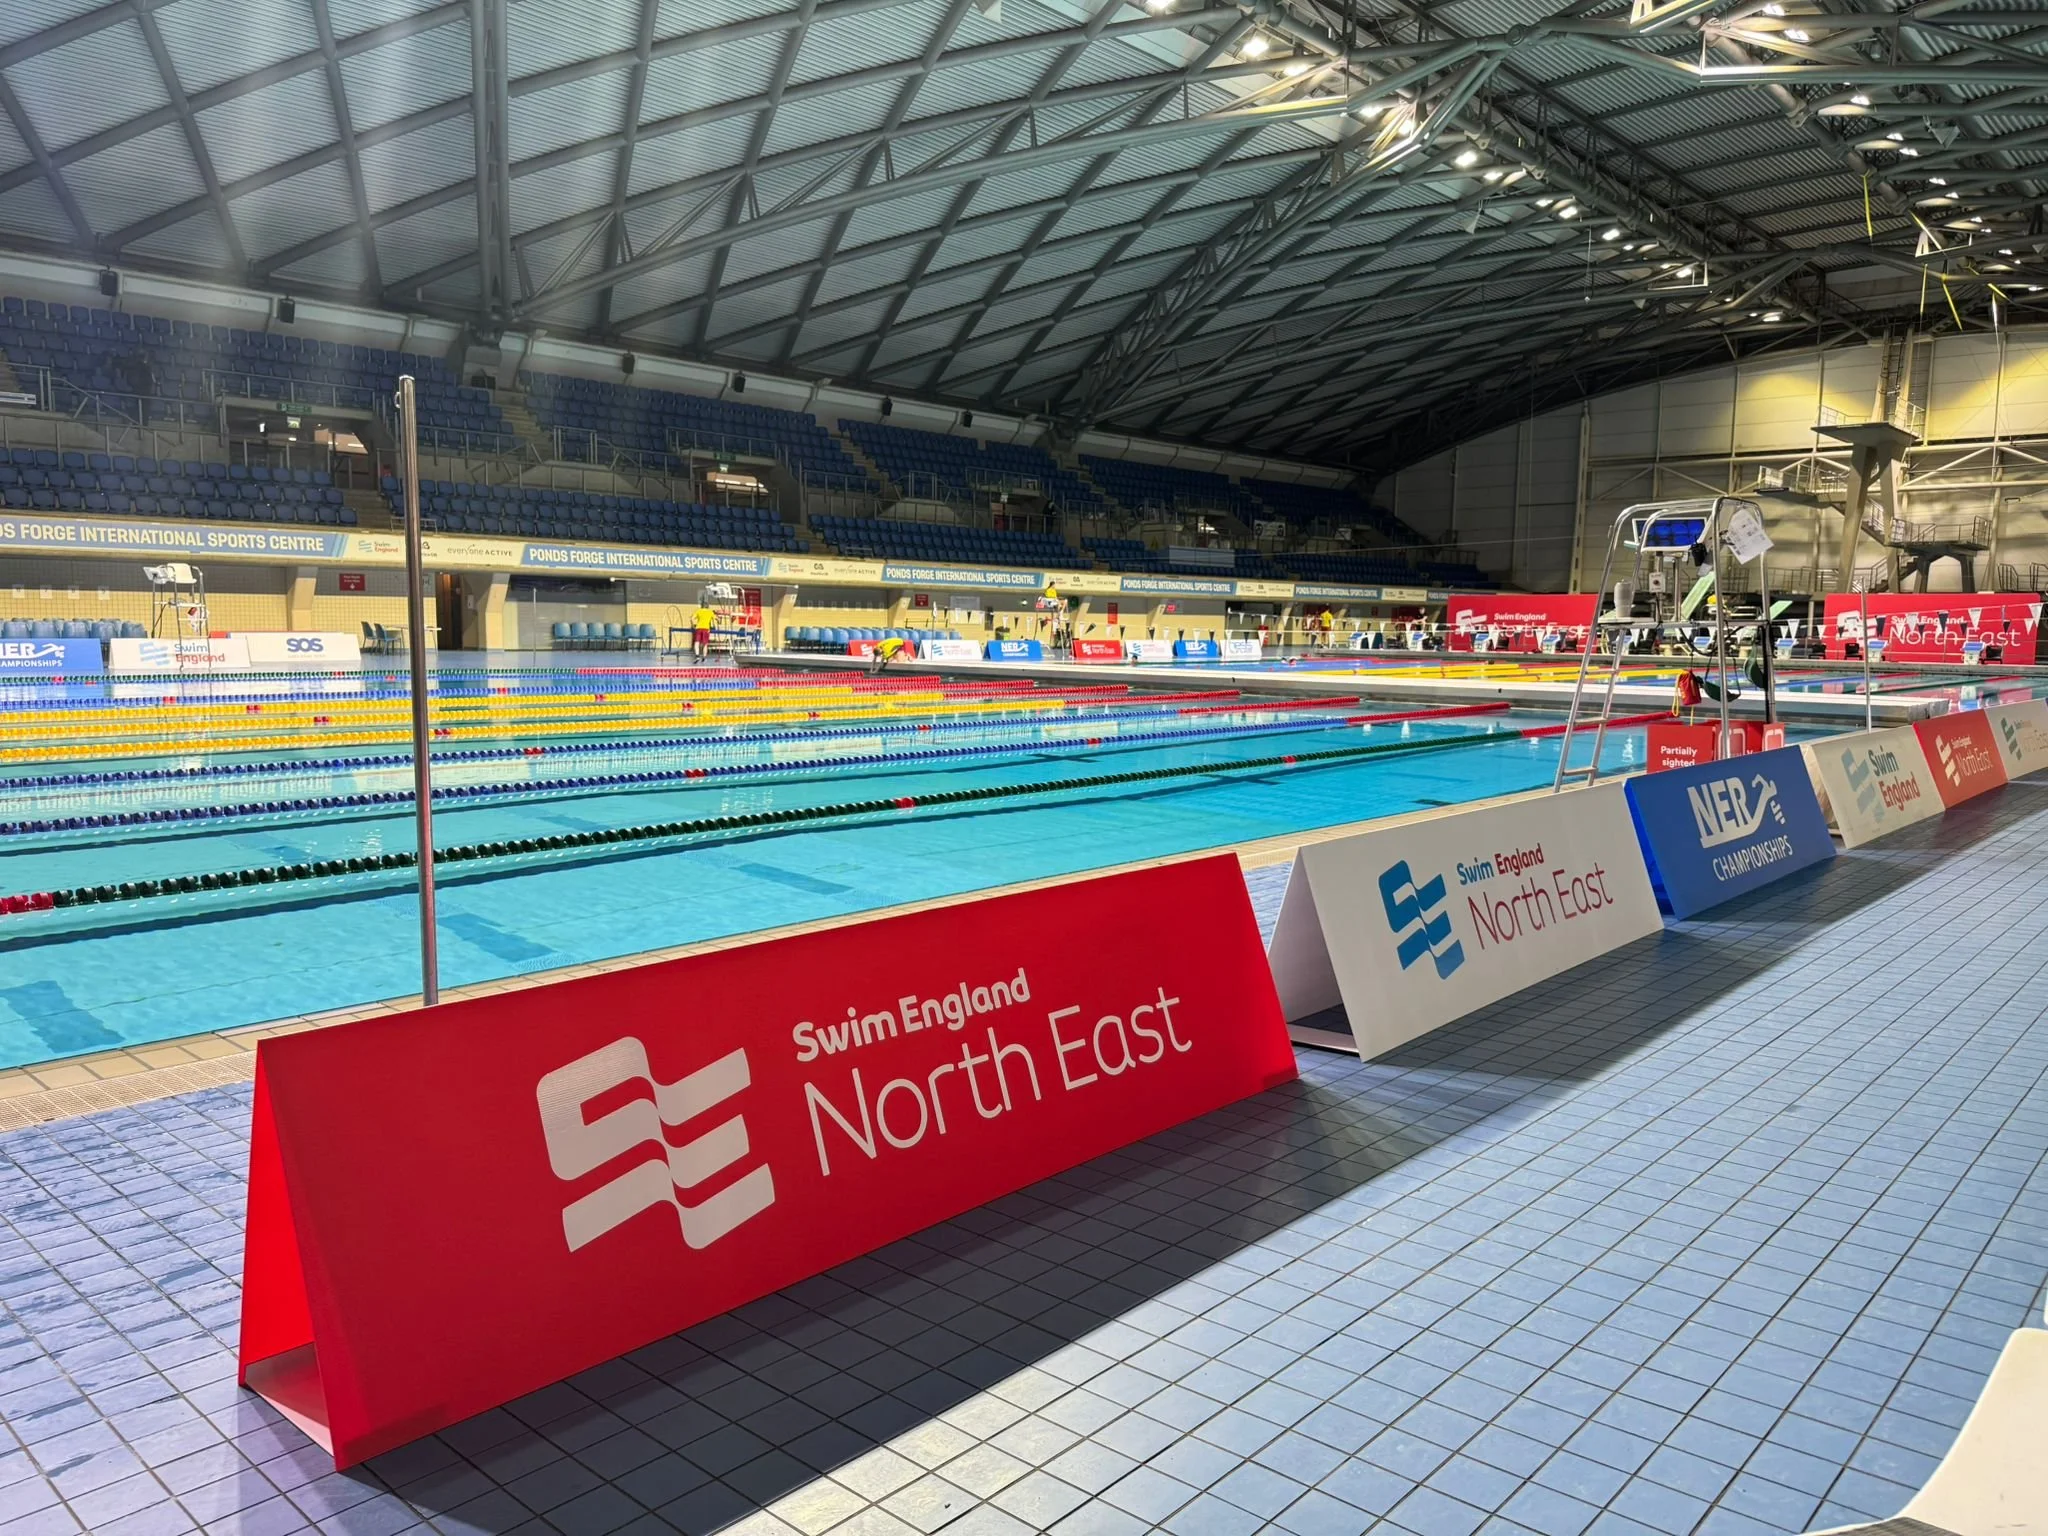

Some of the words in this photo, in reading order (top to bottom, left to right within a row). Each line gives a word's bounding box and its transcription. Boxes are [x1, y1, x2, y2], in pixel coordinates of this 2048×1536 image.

[20, 524, 77, 541] FORGE
[80, 526, 205, 547] INTERNATIONAL
[207, 531, 266, 549] SPORTS
[269, 535, 324, 551] CENTRE
[485, 549, 512, 557] ACTIVE
[529, 548, 569, 563] PONDS
[570, 551, 605, 565] FORGE
[606, 552, 684, 569] INTERNATIONAL
[685, 556, 721, 570] SPORTS
[723, 558, 758, 572] CENTRE
[886, 567, 912, 579] PONDS
[912, 568, 934, 580] FORGE
[935, 570, 985, 583] INTERNATIONAL
[986, 573, 1011, 584] SPORTS
[1012, 574, 1035, 585] CENTRE
[1494, 612, 1514, 620] Swim
[1515, 612, 1546, 622] England
[174, 643, 208, 652] Swim
[286, 638, 324, 652] SOS
[175, 653, 226, 664] England
[1660, 745, 1698, 758] Partially
[1662, 758, 1696, 768] sighted
[1868, 746, 1898, 777] Swim
[1879, 773, 1920, 812] England
[1686, 775, 1751, 838] NER
[1457, 857, 1494, 886] Swim
[1495, 843, 1545, 876] England
[1712, 835, 1794, 882] CHAMPIONSHIPS
[1467, 876, 1557, 951] North
[1555, 862, 1614, 920] East
[792, 1006, 899, 1063] Swim
[899, 967, 1032, 1032] England
[803, 1026, 1043, 1177] North
[1047, 986, 1193, 1092] East
